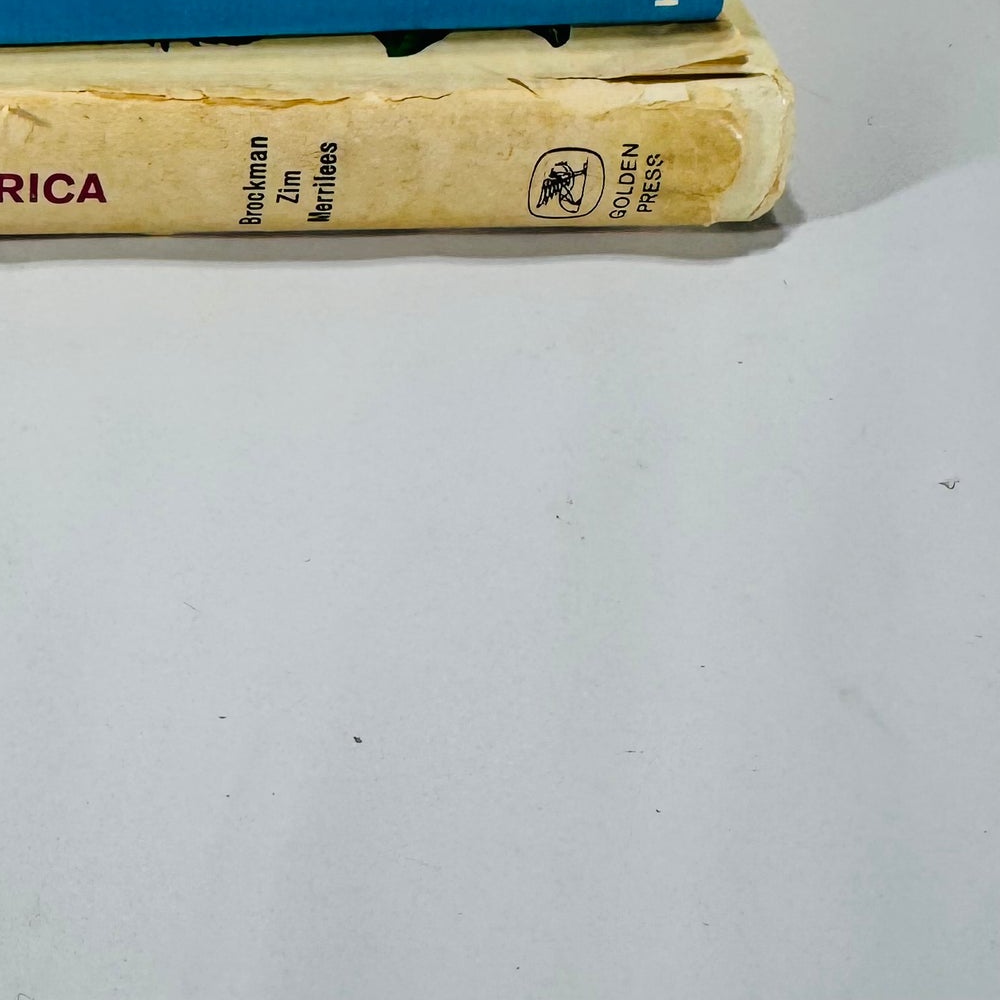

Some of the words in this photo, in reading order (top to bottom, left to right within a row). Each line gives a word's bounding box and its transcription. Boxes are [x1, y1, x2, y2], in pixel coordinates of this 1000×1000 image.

[239, 136, 269, 226] Brockman
[276, 169, 301, 205] Zim
[307, 141, 338, 224] Merrilees
[609, 143, 639, 219] GOLDEN
[636, 153, 664, 213] PRESS
